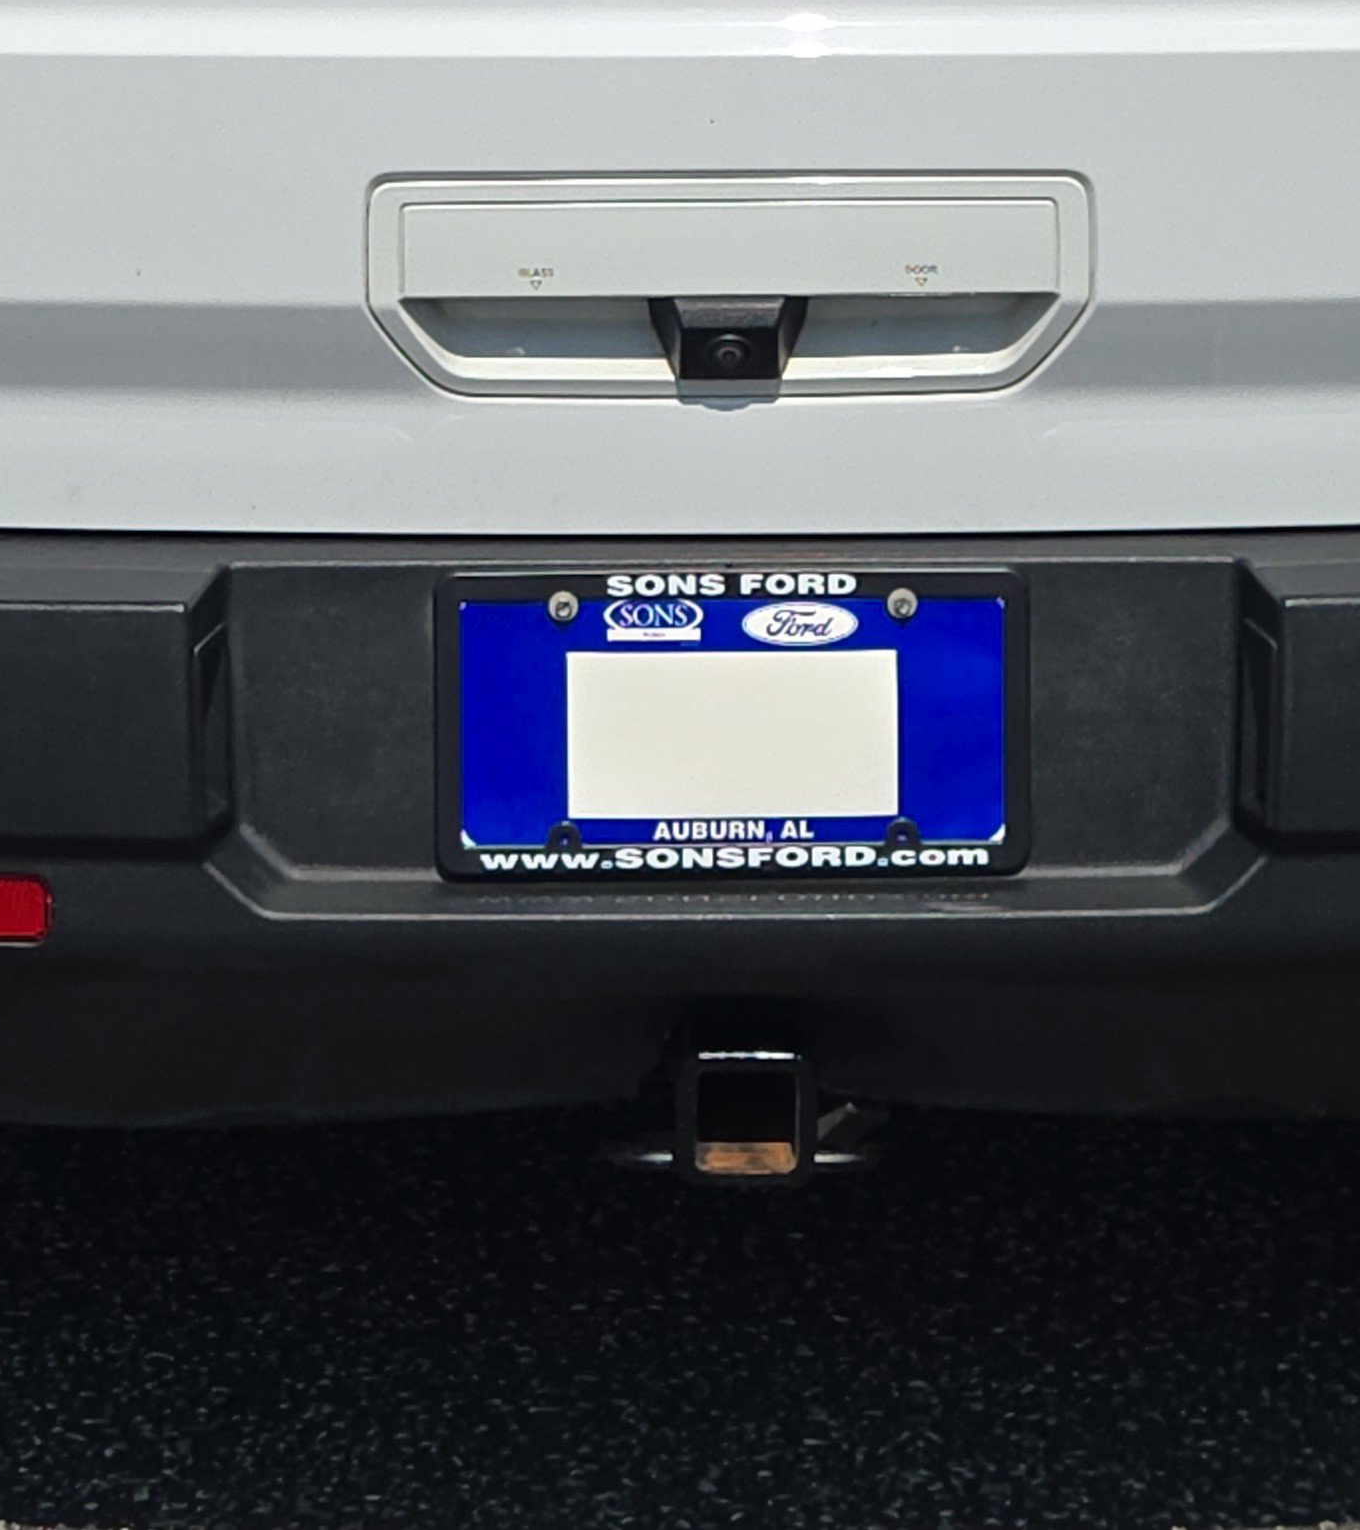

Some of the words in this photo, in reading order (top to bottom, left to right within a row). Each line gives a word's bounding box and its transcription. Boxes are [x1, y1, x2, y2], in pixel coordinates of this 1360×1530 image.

[606, 573, 726, 597] SONS
[740, 573, 857, 596] FORD
[619, 603, 688, 627] SONS
[766, 609, 834, 637] Ford
[652, 820, 773, 844] AUBURN,
[780, 819, 815, 840] AL
[479, 845, 990, 870] www.SONSFORD.com
